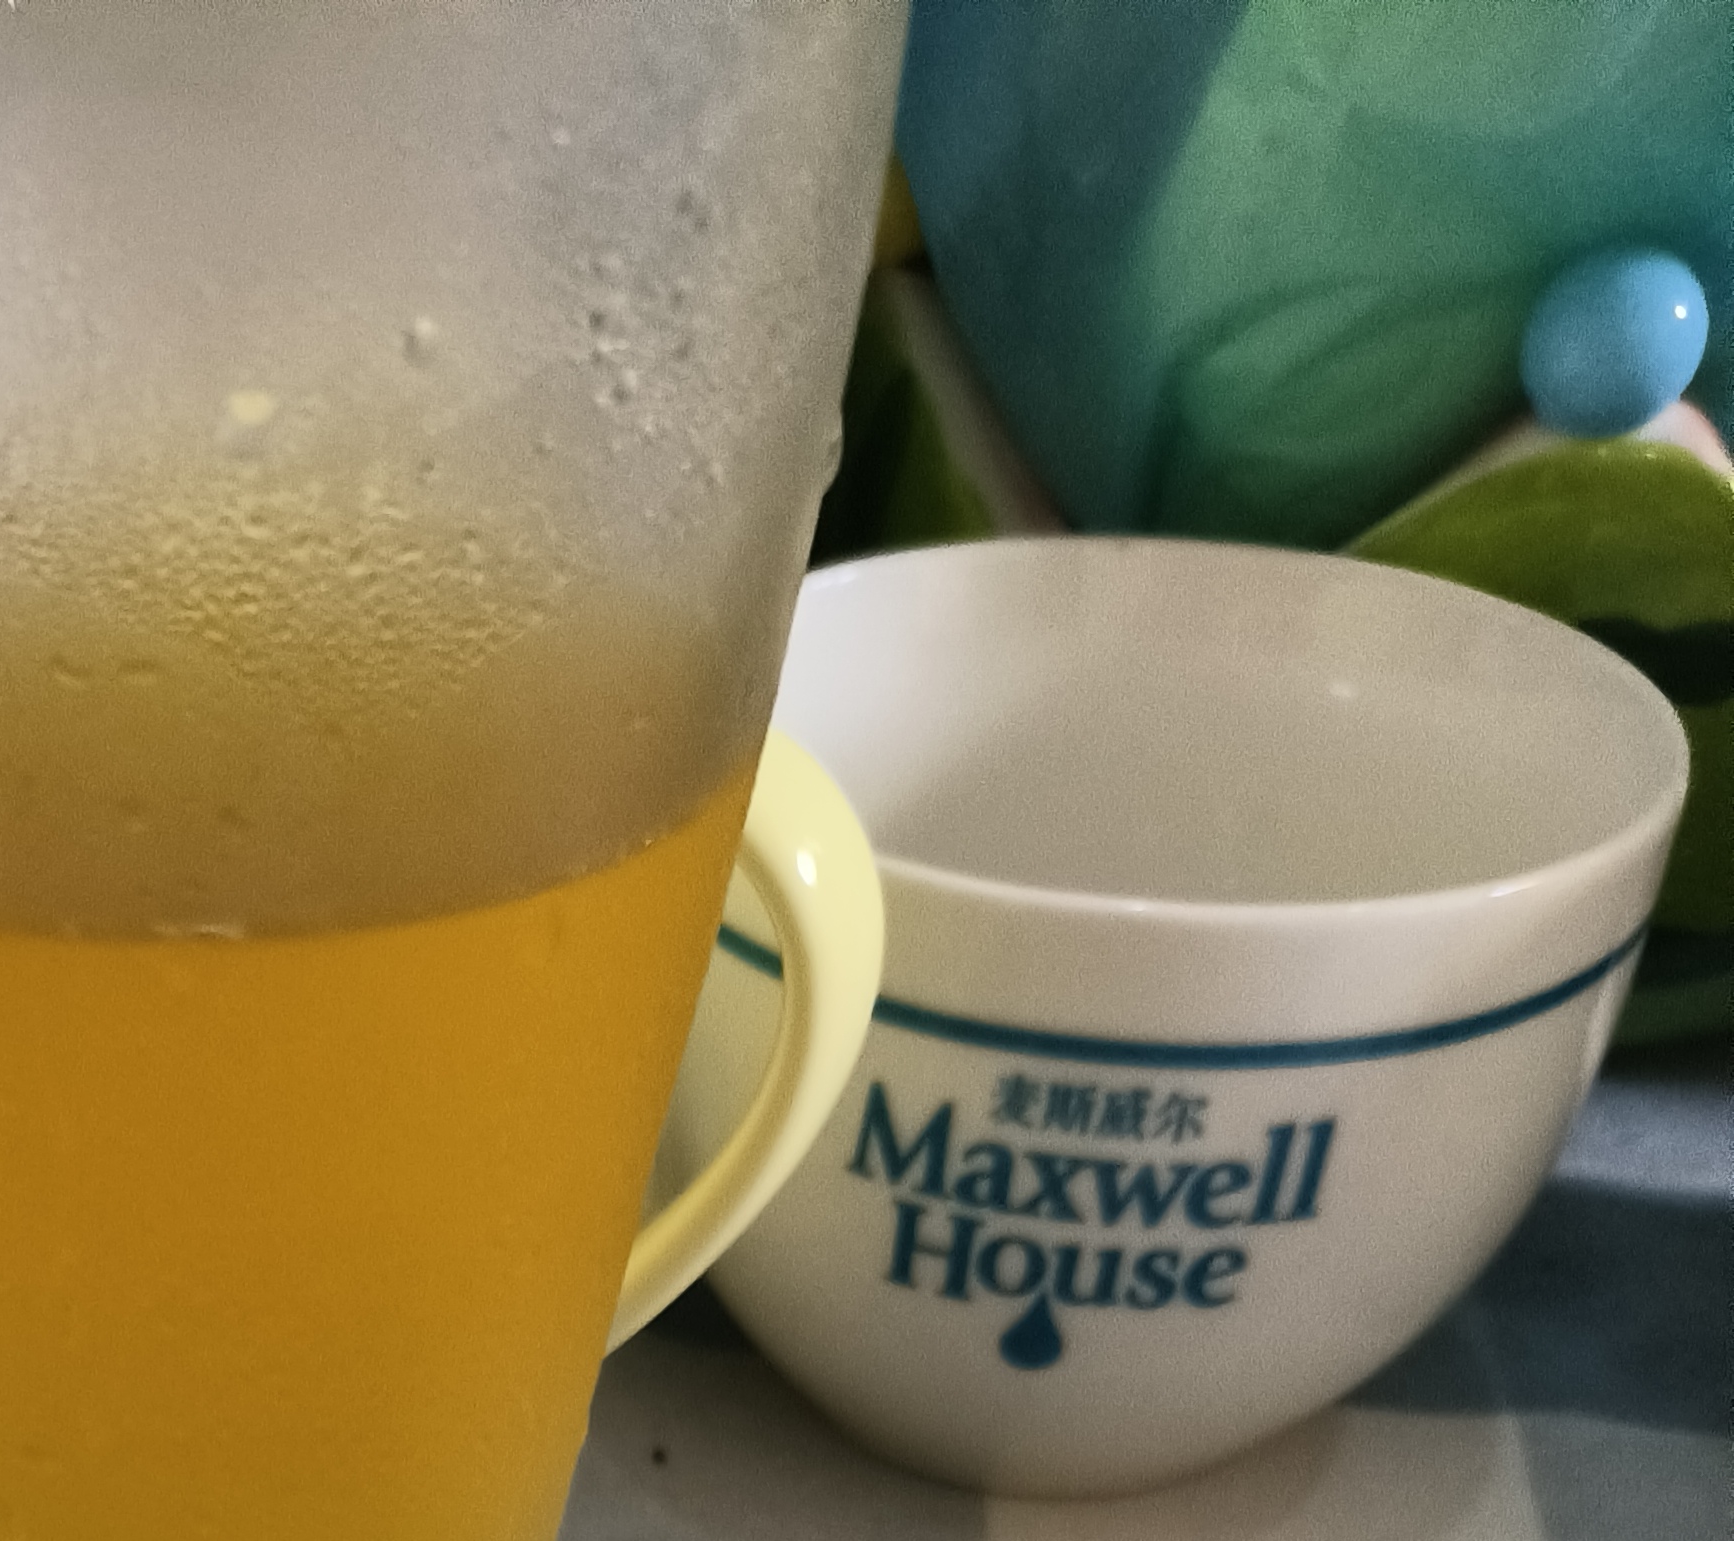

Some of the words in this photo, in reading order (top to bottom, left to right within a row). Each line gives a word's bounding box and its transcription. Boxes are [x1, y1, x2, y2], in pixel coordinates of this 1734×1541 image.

[848, 1080, 1337, 1229] Maxwell
[992, 1073, 1208, 1143] 麦斯威尔
[885, 1199, 1248, 1310] House
